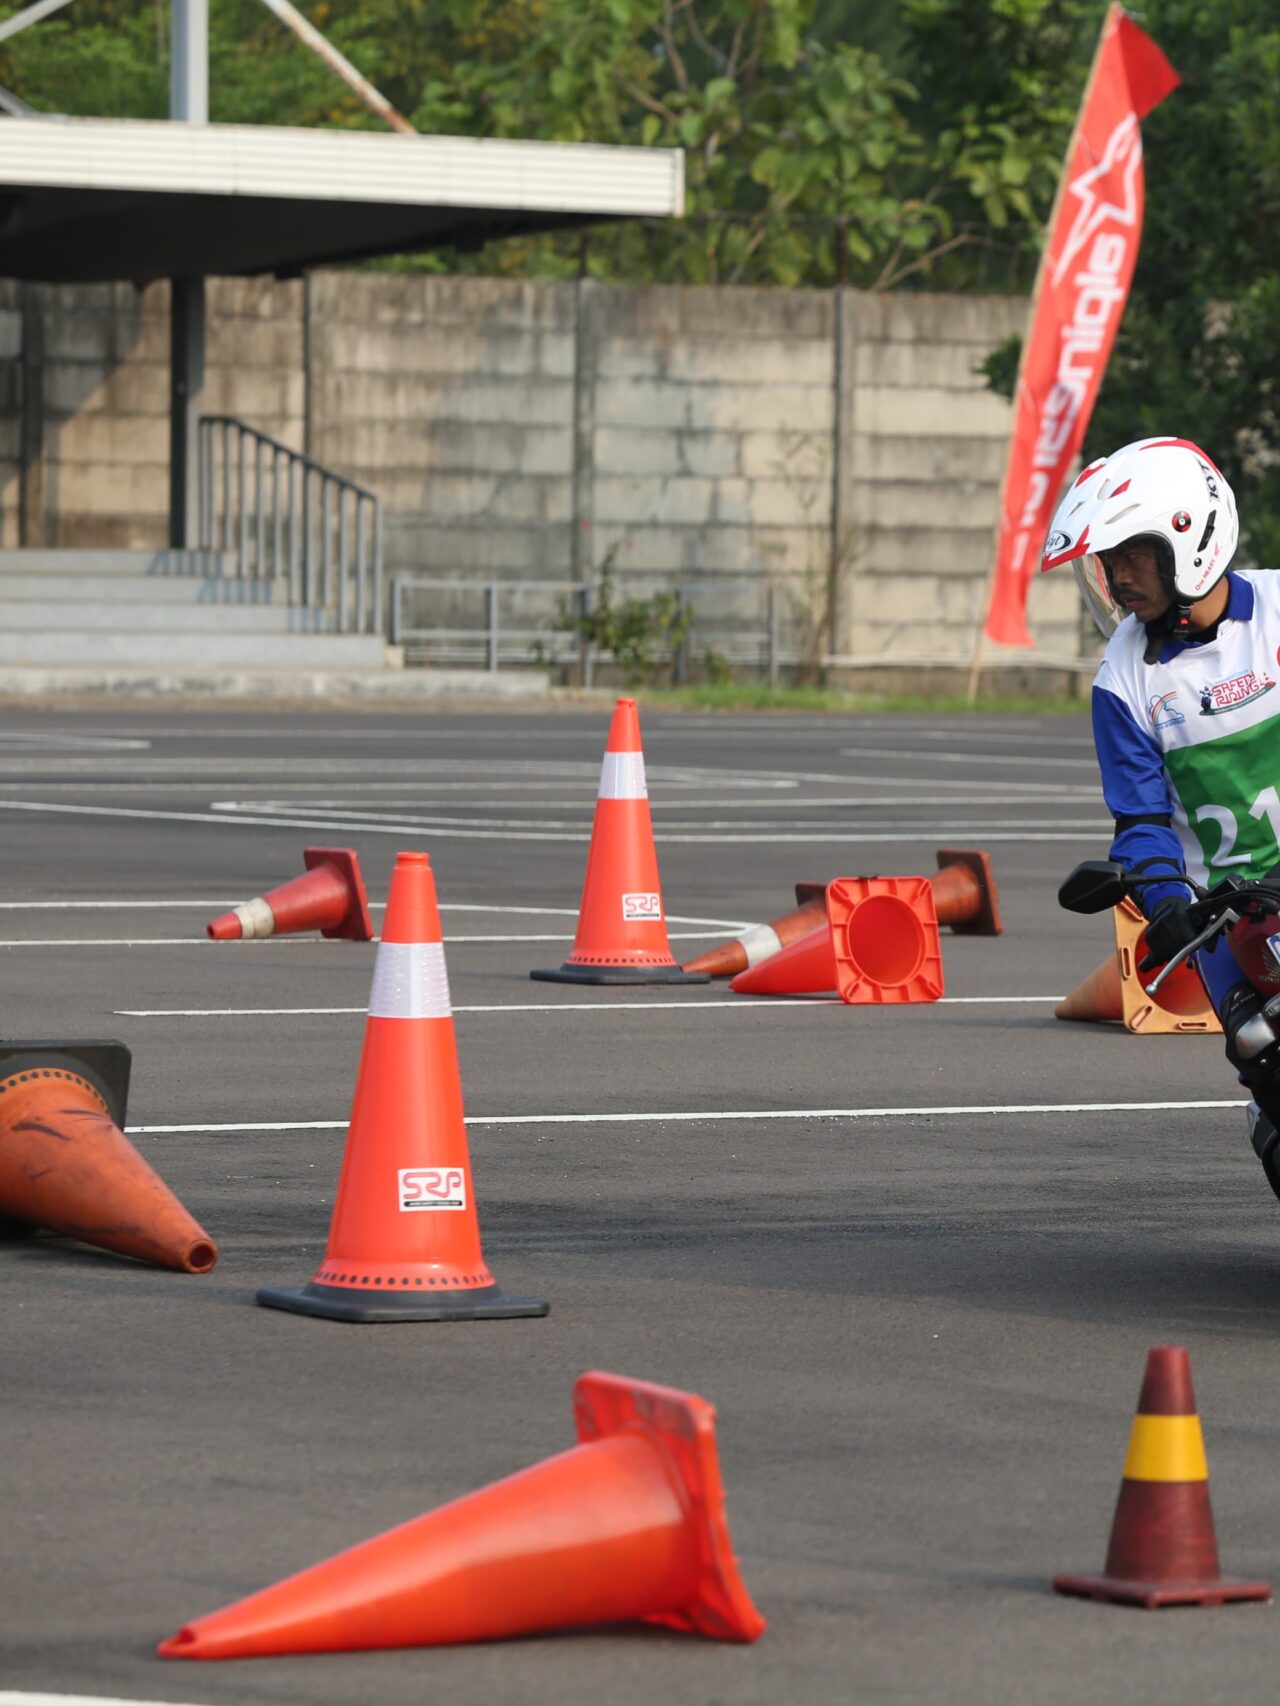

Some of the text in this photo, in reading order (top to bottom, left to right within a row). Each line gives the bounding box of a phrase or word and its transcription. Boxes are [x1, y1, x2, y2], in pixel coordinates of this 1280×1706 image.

[1212, 670, 1255, 697] SAFETY
[1216, 680, 1260, 707] RIDING
[624, 895, 659, 913] SRP
[402, 1171, 462, 1199] SRP
